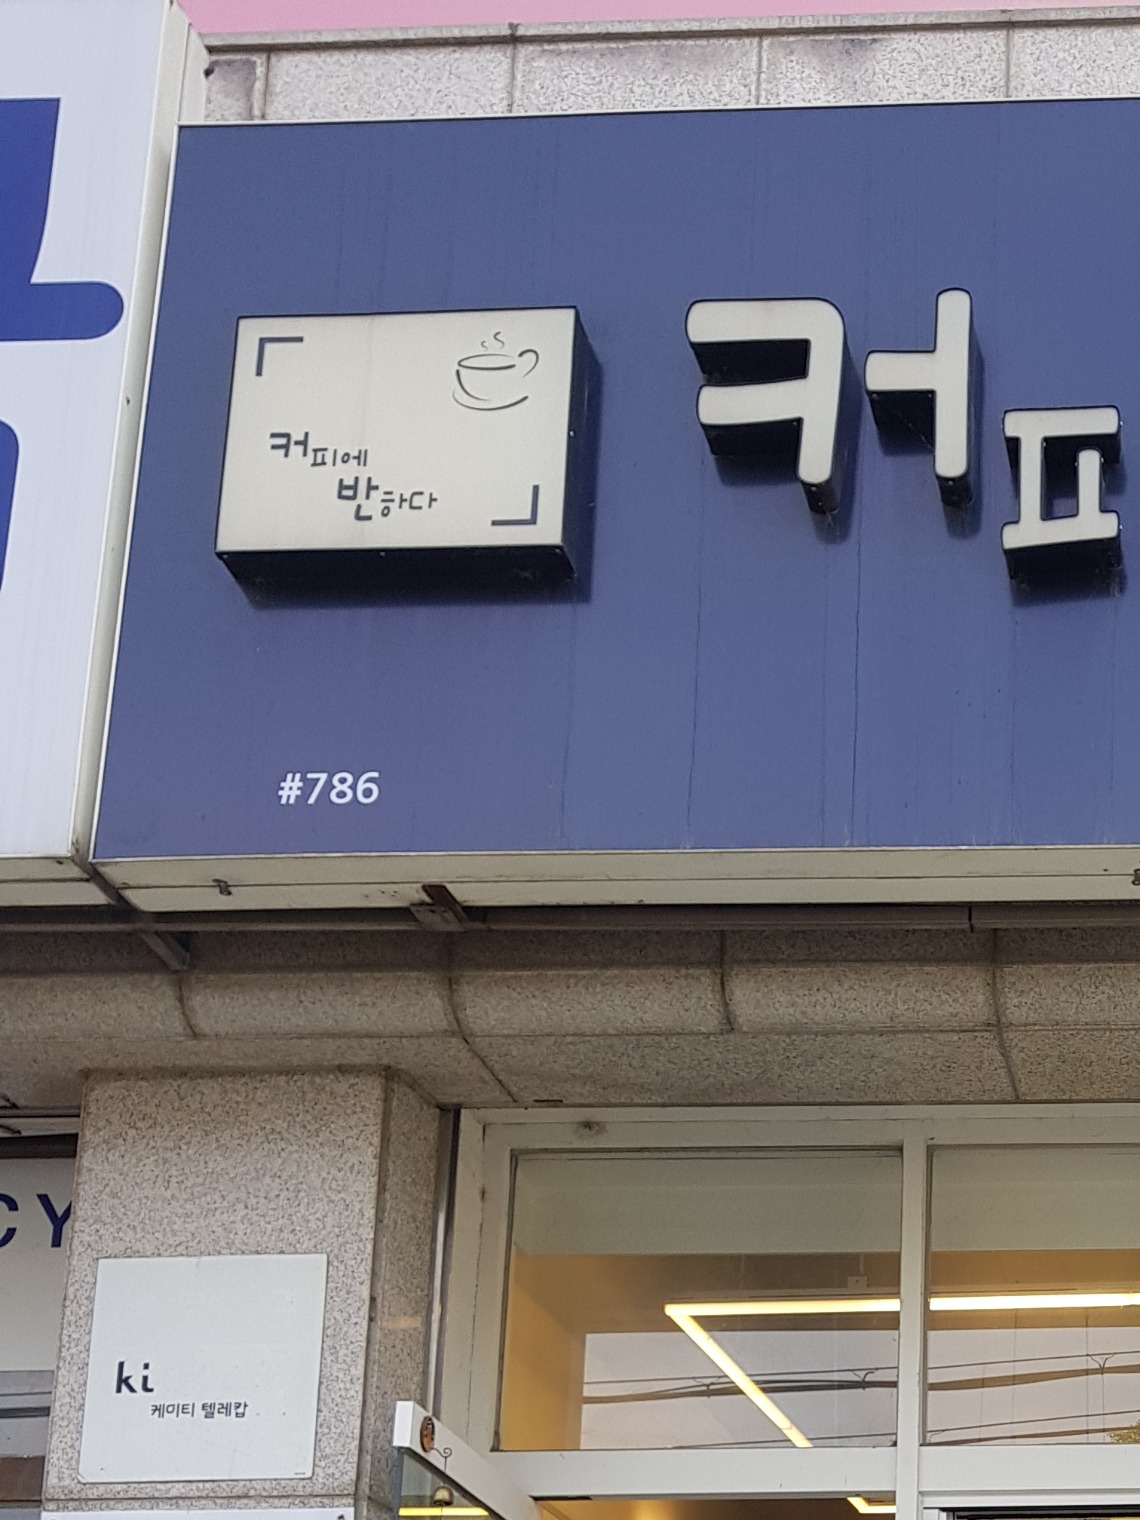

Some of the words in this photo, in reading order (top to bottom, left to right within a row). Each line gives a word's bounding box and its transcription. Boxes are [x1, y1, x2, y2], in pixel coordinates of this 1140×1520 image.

[270, 431, 368, 467] 커피에
[337, 476, 437, 522] 반하다
[278, 771, 381, 805] #786
[201, 1401, 249, 1419] 텔레캅
